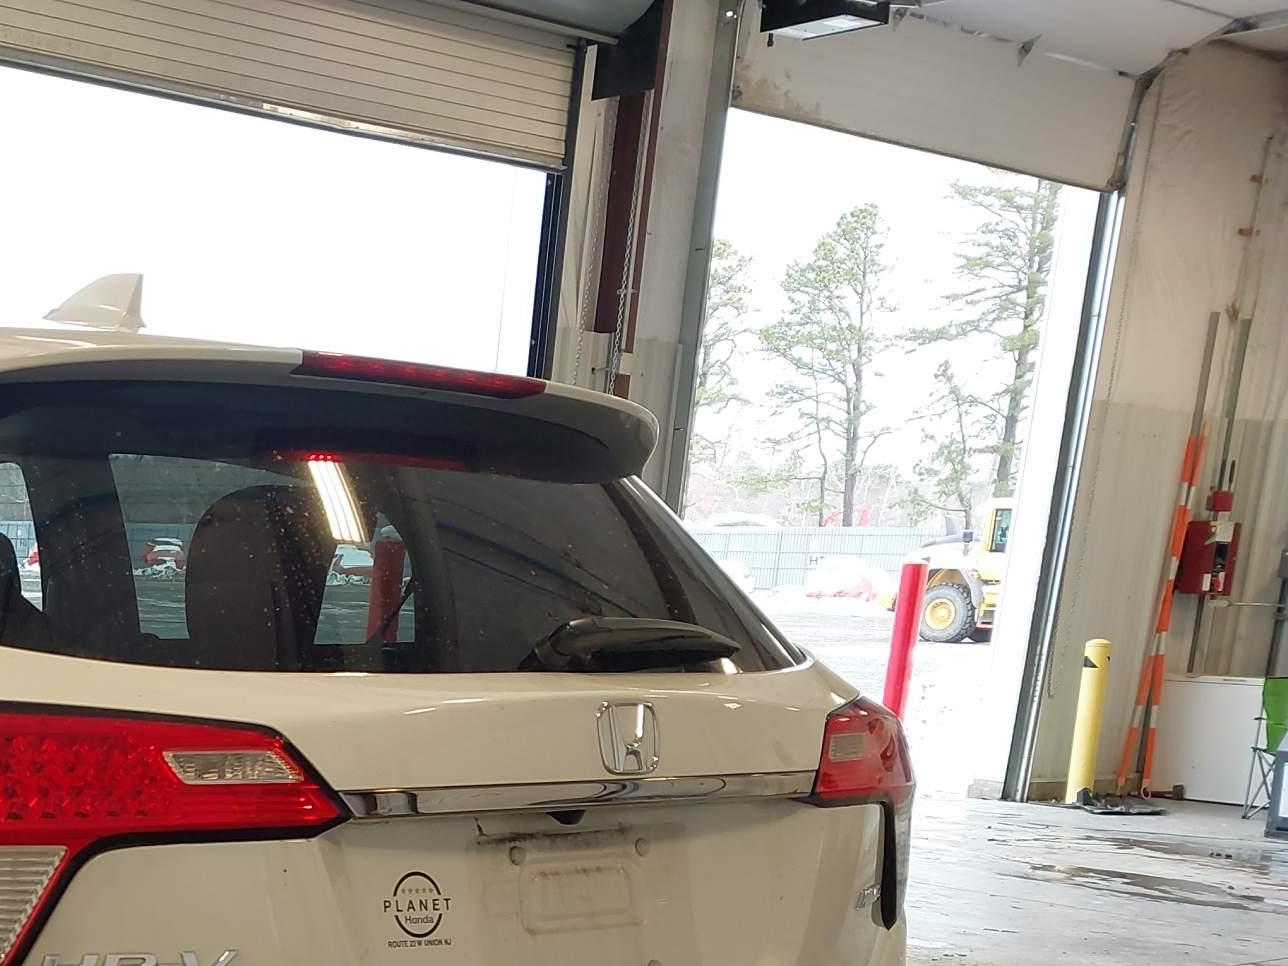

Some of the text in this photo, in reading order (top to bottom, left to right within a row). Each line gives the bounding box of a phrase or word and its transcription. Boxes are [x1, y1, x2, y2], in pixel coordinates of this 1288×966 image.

[383, 898, 452, 913] PLANET
[404, 914, 435, 925] Honda
[387, 940, 409, 949] ROUTE
